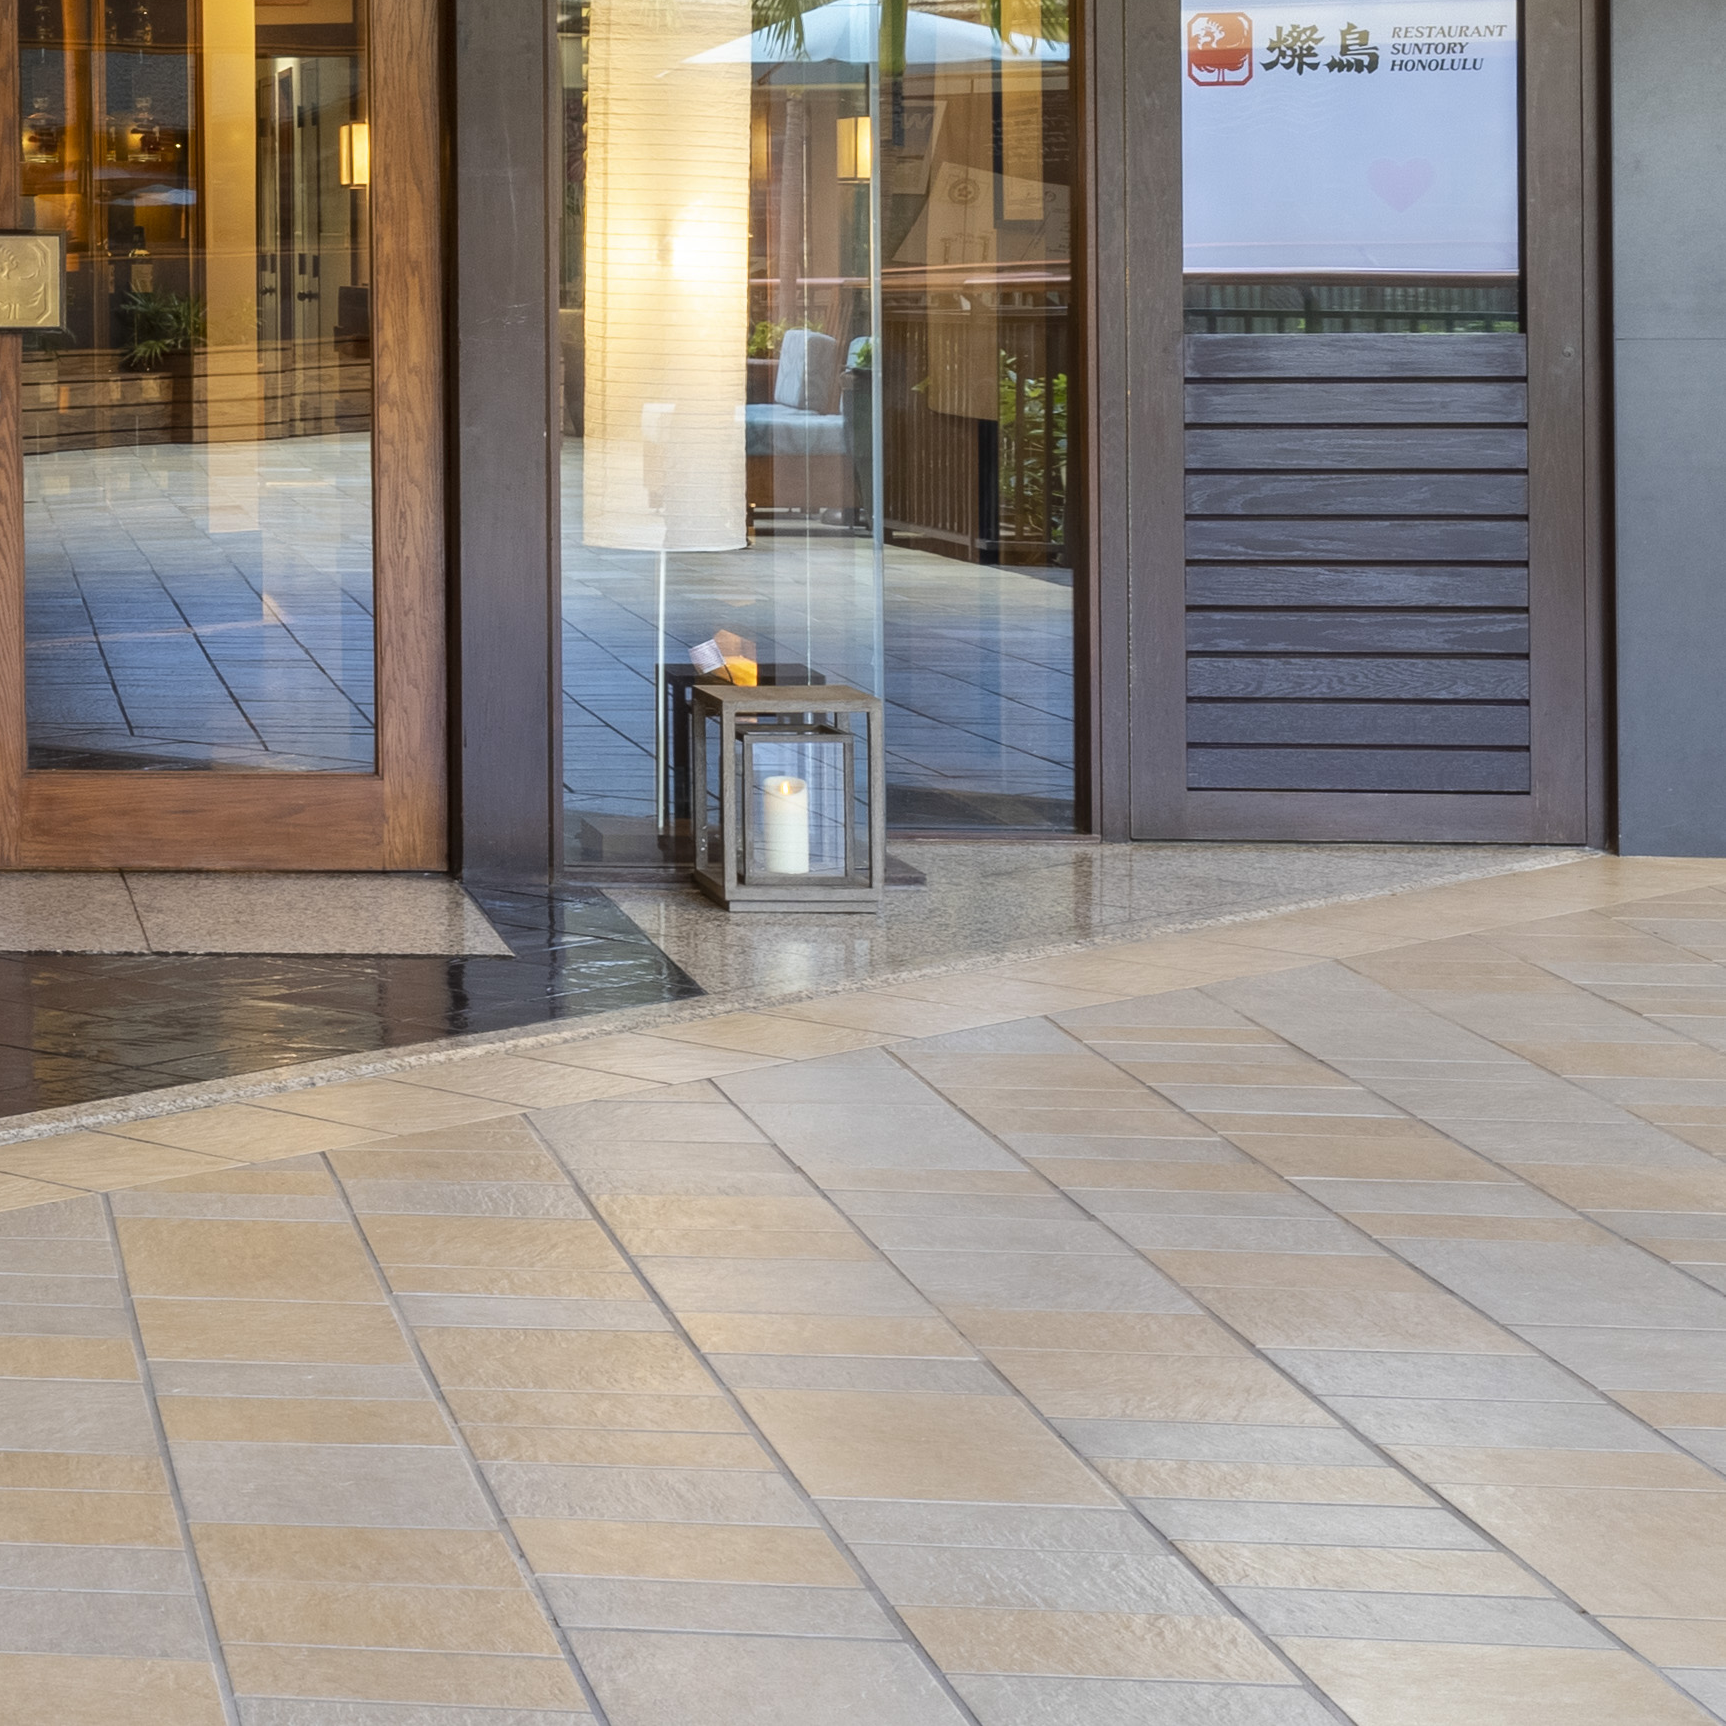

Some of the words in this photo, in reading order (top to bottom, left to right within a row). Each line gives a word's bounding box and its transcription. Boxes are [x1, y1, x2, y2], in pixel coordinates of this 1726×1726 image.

[1391, 24, 1507, 39] RESTAURANT
[1259, 21, 1380, 76] 燦鳥
[1390, 42, 1469, 56] SUNTORY
[1390, 58, 1484, 72] HONOLULU
